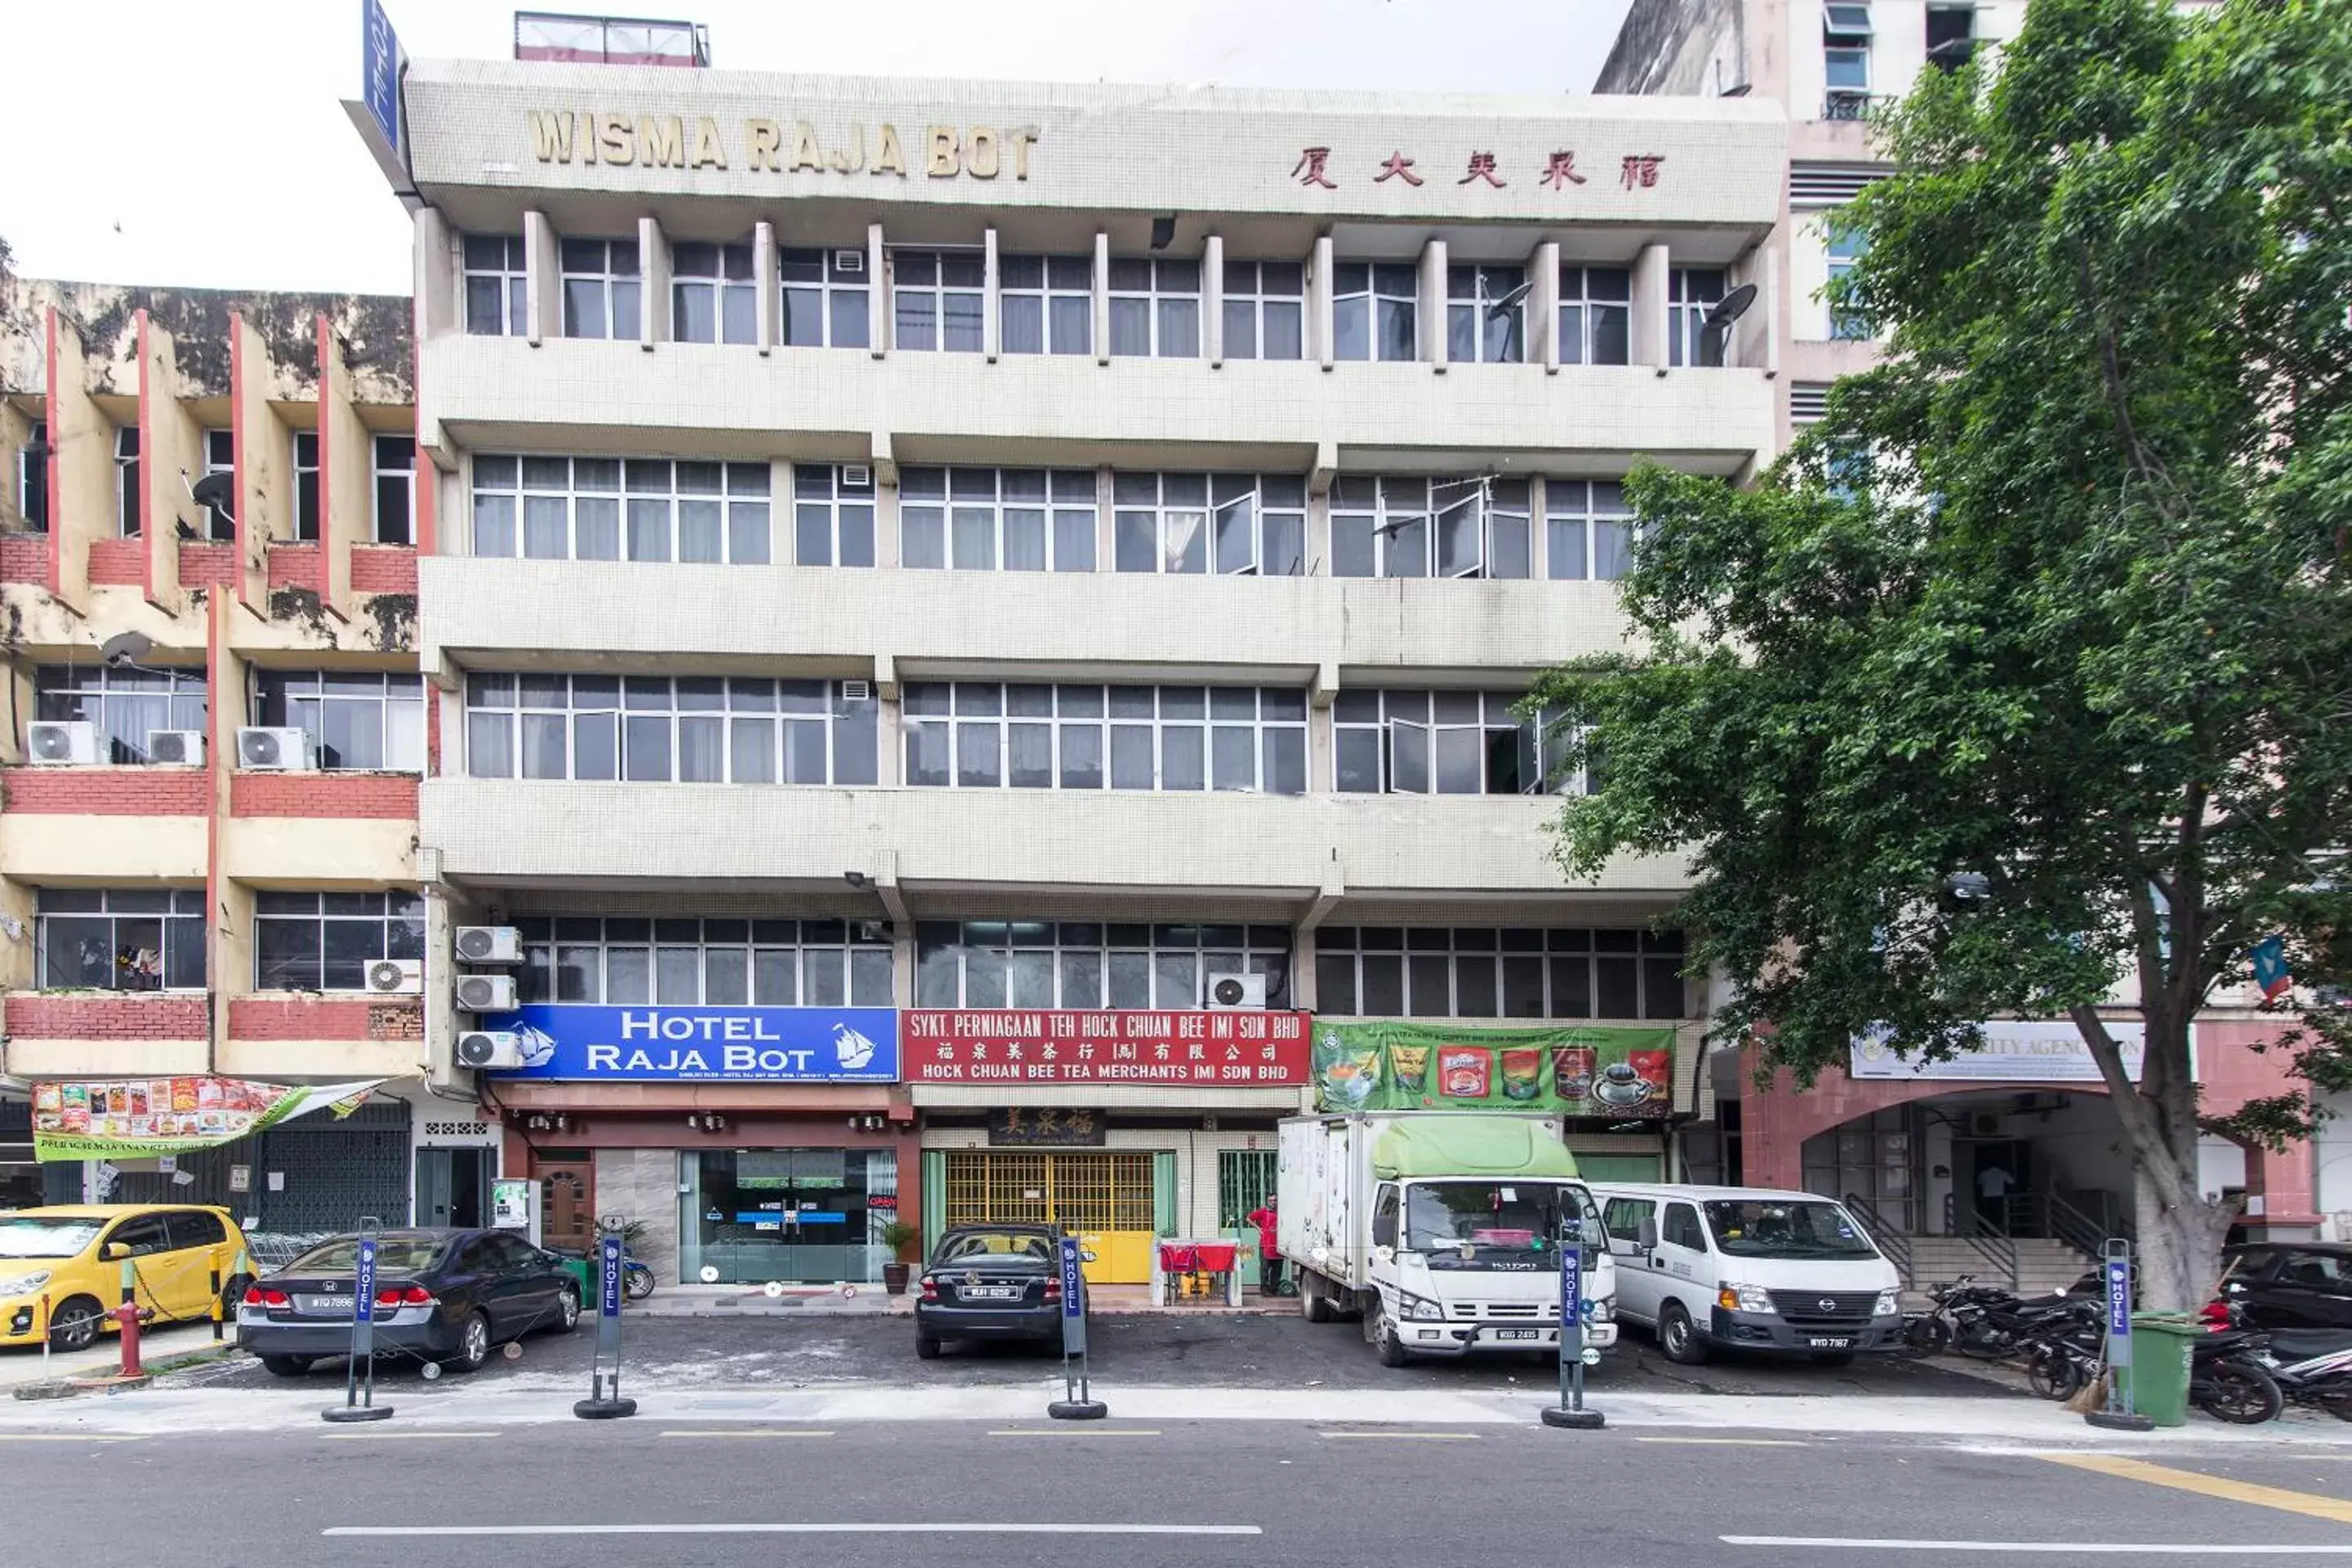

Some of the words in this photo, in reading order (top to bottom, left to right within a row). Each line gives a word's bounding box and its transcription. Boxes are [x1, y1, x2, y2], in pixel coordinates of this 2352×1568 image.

[527, 110, 728, 170] WISMA
[743, 117, 907, 176] RAJA
[927, 124, 1040, 181] BOT
[621, 1011, 781, 1040] HOTEL
[911, 1013, 950, 1038] SYKT.
[955, 1013, 1042, 1038] PERNIAGAAN
[1049, 1014, 1075, 1038] TEH
[1082, 1015, 1119, 1038] HOCK
[1126, 1015, 1172, 1039] CHUAN
[1178, 1015, 1205, 1039] BEE
[1240, 1016, 1266, 1040] SDN
[1272, 1016, 1301, 1040] BHD
[586, 1044, 710, 1071] RAJA
[723, 1044, 815, 1071] BOT
[922, 1064, 964, 1079] HOCK
[970, 1064, 1020, 1079] CHUAN
[1027, 1064, 1055, 1079] BEE
[1062, 1064, 1091, 1079] TEA
[1098, 1064, 1187, 1080] MERCHANTS
[1222, 1065, 1250, 1080] SDN
[1258, 1066, 1288, 1080] BHD
[360, 1263, 372, 1313] HOTEL
[606, 1261, 617, 1309] HOTEL
[1066, 1262, 1077, 1309] HOTEL
[1566, 1272, 1577, 1320] HOTEL
[2112, 1283, 2124, 1328] HOTEL
